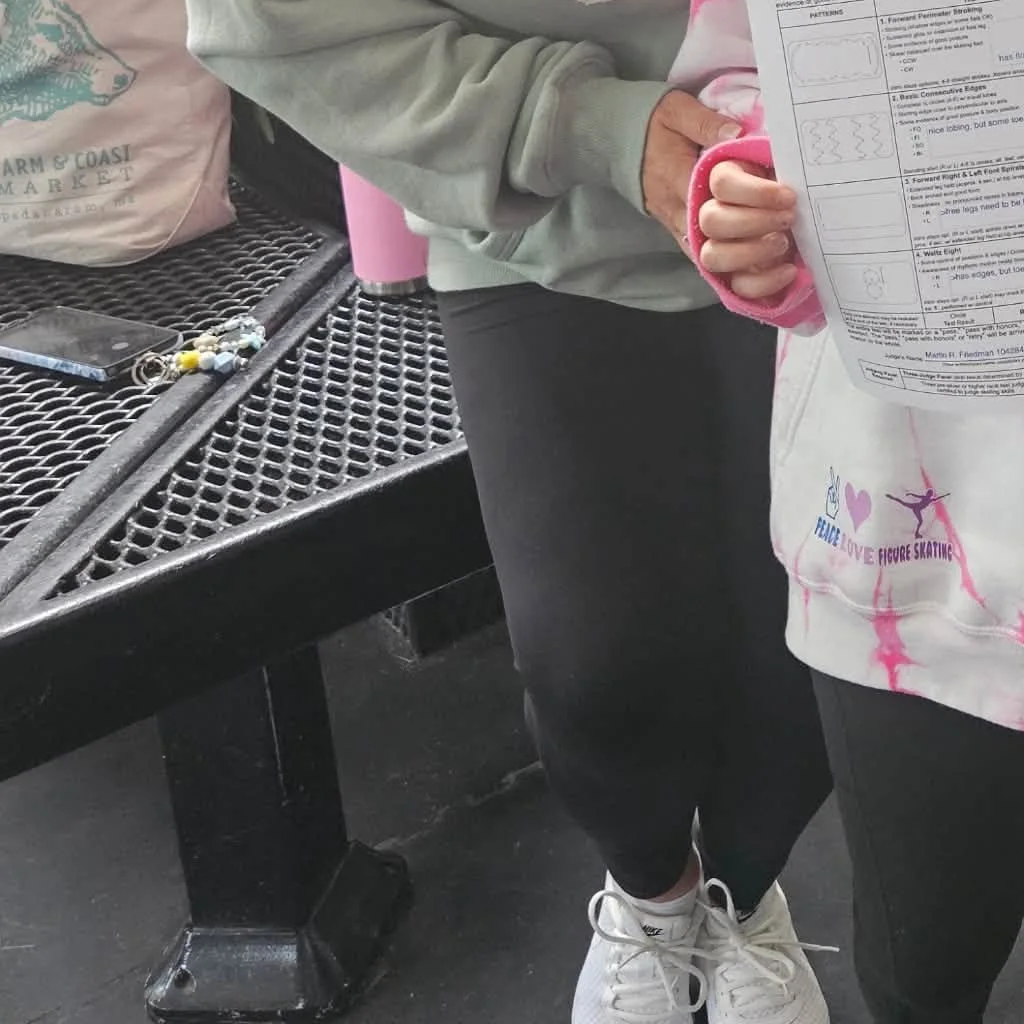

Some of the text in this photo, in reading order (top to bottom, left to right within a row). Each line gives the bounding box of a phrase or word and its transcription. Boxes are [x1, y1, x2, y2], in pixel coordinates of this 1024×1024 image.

[809, 8, 843, 18] PATTERNS
[887, 14, 915, 23] Forward
[917, 9, 951, 19] Perimeter
[953, 5, 982, 15] Stroking
[998, 53, 1012, 61] has
[920, 86, 962, 97] Consecutive
[964, 84, 986, 93] Edges
[928, 126, 944, 134] nice
[973, 120, 986, 128] but
[988, 118, 1009, 126] some
[911, 174, 940, 183] Forward
[941, 172, 960, 180] Right
[962, 204, 978, 213] legs
[979, 201, 999, 209] need
[943, 247, 961, 255] Eight
[1013, 265, 1024, 273] toe
[925, 351, 948, 359] Martin
[959, 350, 994, 359] Friedman
[814, 517, 953, 567] PEACE LOVE FIGURE SKATING
